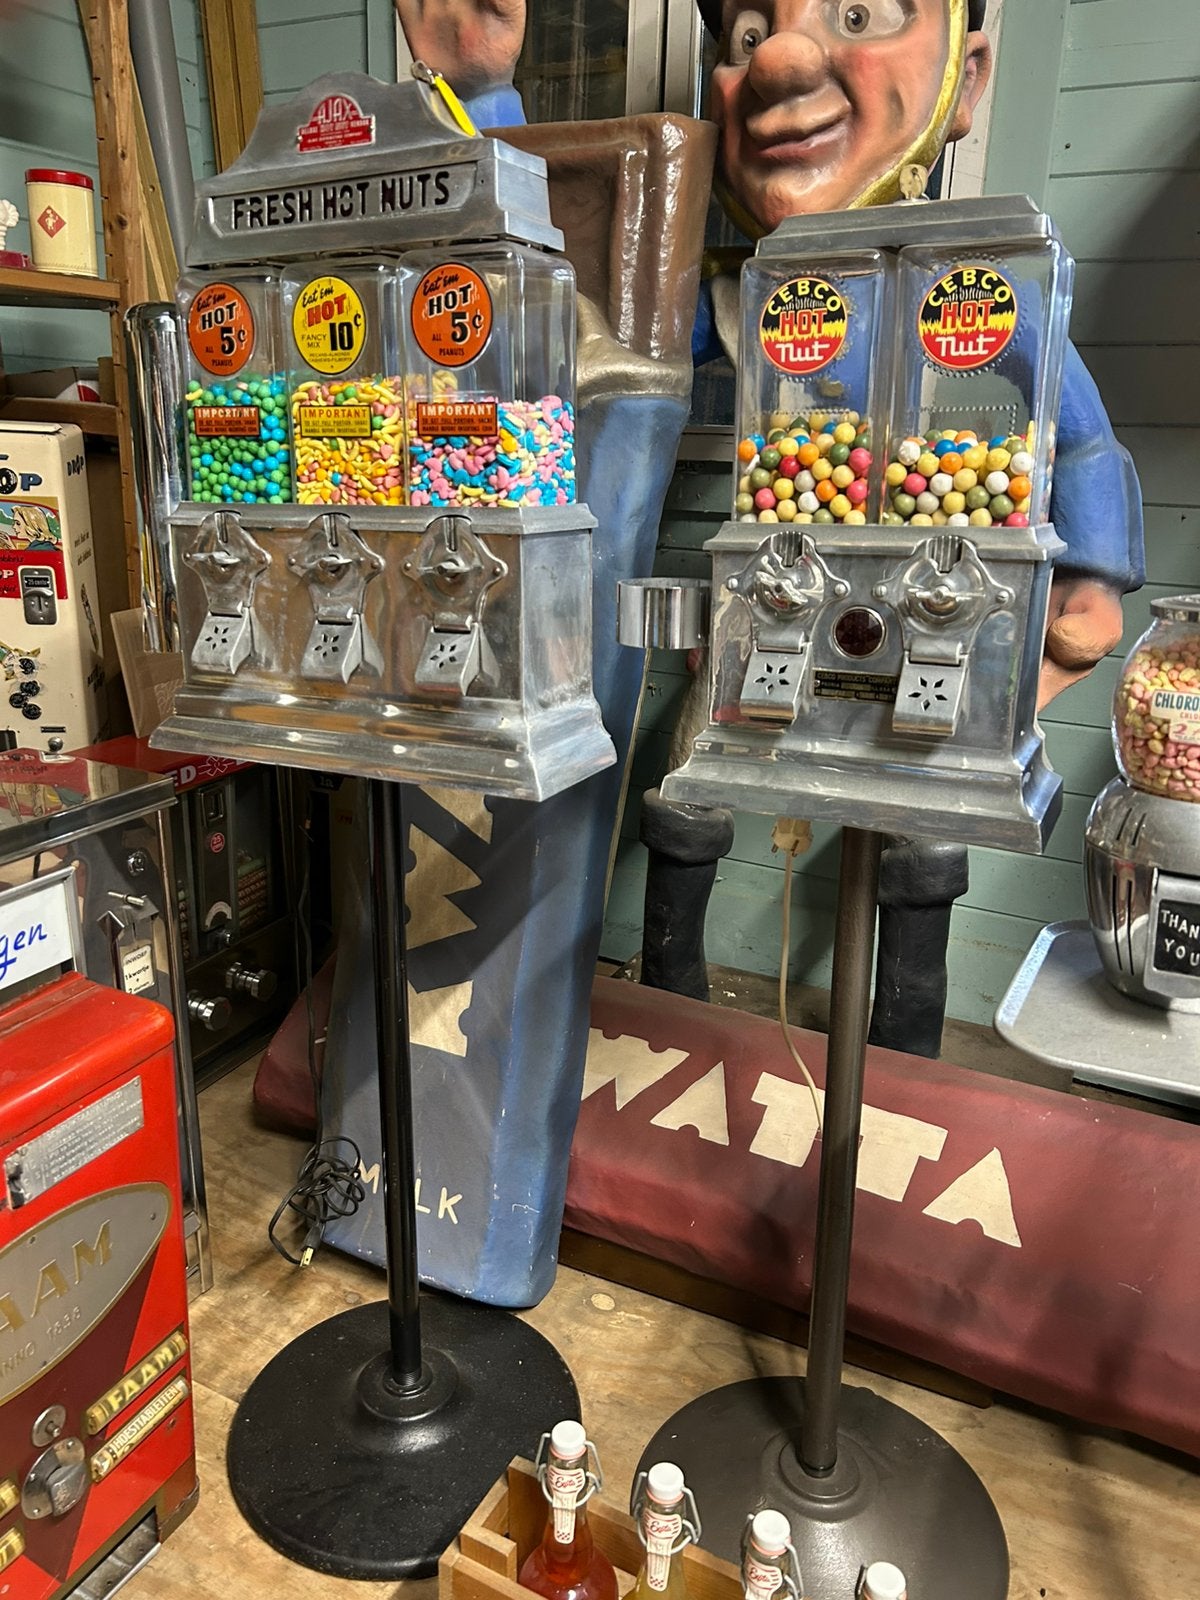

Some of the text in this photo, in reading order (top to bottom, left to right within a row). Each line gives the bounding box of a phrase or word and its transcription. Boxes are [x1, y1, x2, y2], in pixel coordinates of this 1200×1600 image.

[316, 98, 353, 124] AJAX
[232, 171, 449, 230] FRESH HOT NUTS
[428, 282, 473, 317] HOT
[767, 280, 841, 315] CEBCO
[928, 269, 1011, 307] CEBCO
[201, 301, 238, 330] HOT
[307, 293, 347, 328] HOT
[780, 308, 828, 338] HOT
[941, 299, 996, 330] HOT
[301, 333, 327, 341] FANCY
[431, 333, 442, 342] ALL
[935, 333, 997, 357] Nut
[438, 347, 465, 357] PEANUTS
[775, 341, 831, 363] Nut
[304, 408, 367, 418] IMPORTANT
[421, 404, 493, 416] IMPORTANT
[1164, 938, 1200, 967] YOU
[353, 1156, 462, 1225] MLK
[107, 1346, 174, 1412] FAAM
